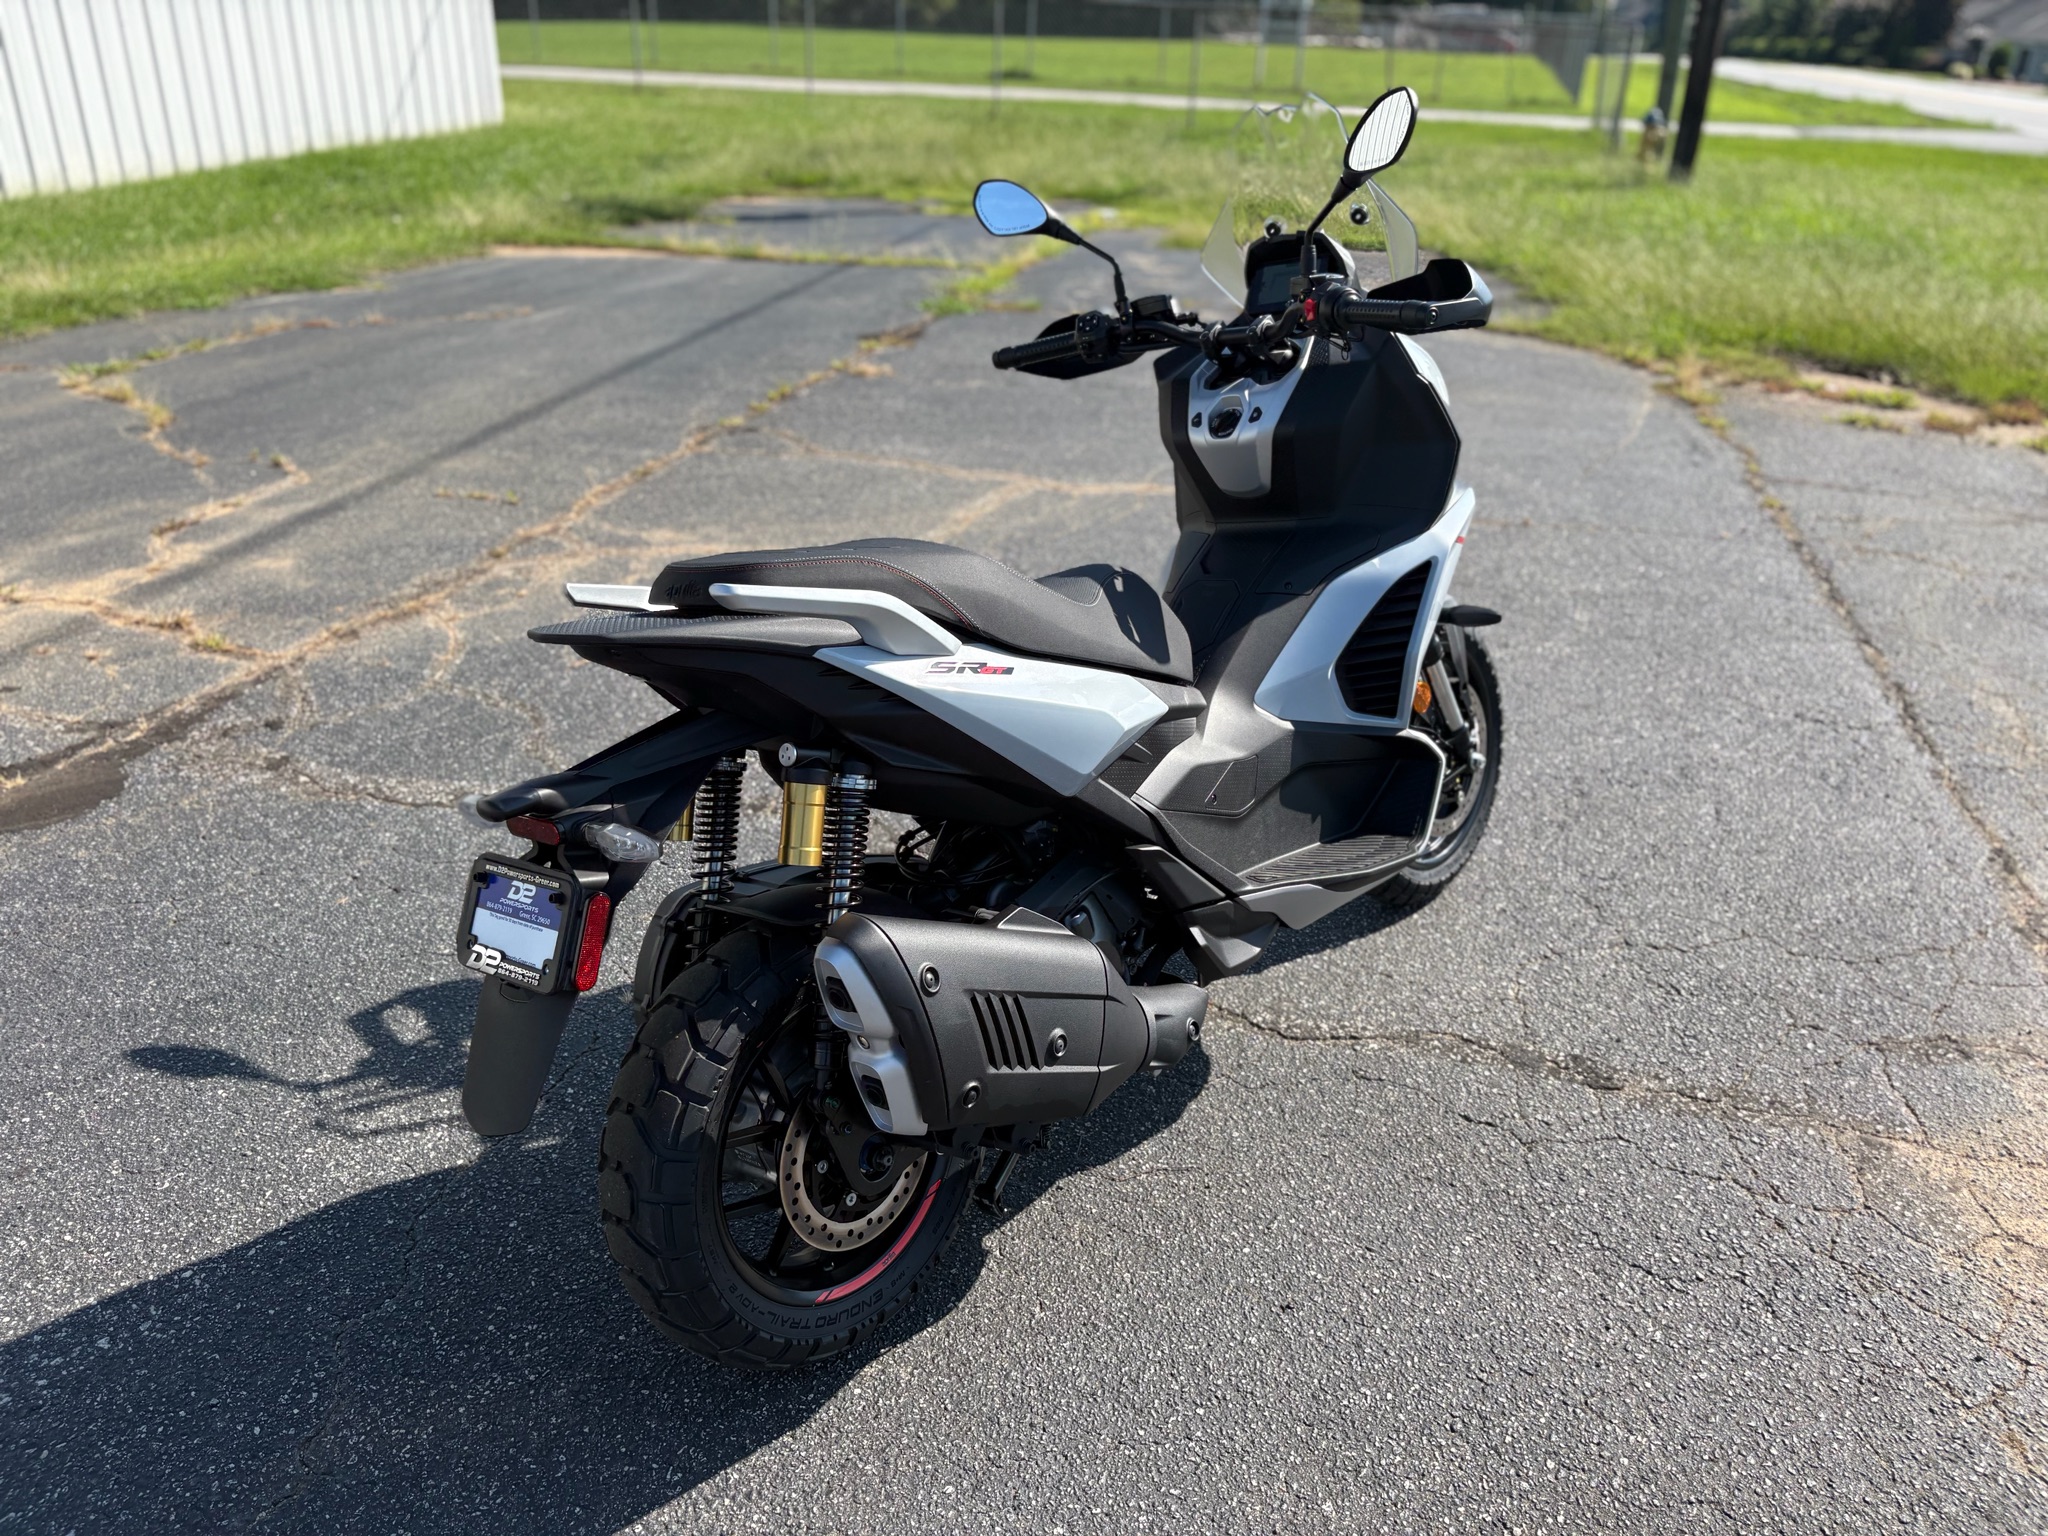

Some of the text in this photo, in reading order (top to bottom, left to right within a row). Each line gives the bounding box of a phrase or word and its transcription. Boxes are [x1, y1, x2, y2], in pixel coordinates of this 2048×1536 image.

[925, 661, 987, 675] SR
[507, 880, 537, 904] D2
[499, 897, 539, 913] POWERSPORTS
[465, 944, 502, 975] D2
[497, 967, 539, 986] 864-879-2119
[499, 961, 541, 980] POWERSPORTS
[815, 1288, 884, 1330] ENDURO
